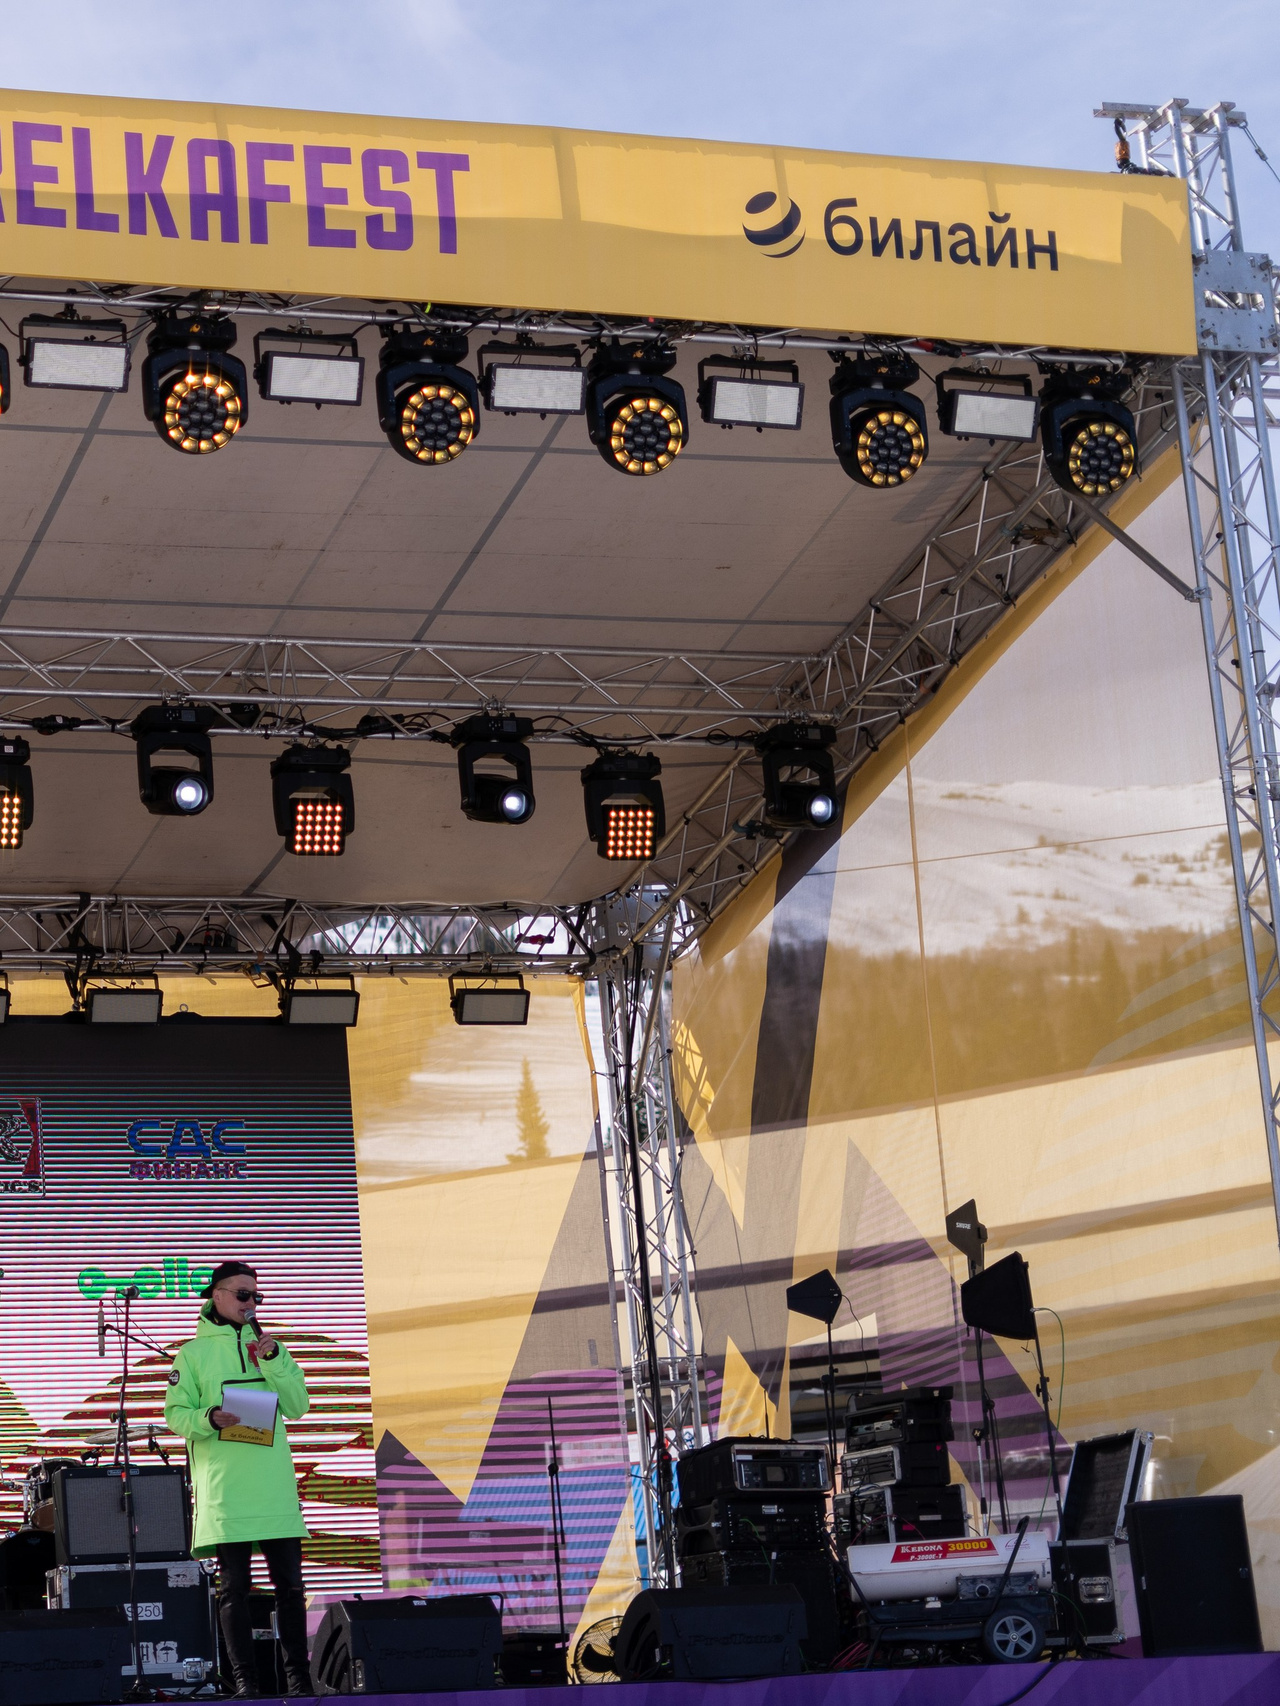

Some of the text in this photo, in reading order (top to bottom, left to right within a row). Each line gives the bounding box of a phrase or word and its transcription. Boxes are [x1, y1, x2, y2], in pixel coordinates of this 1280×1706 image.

[823, 198, 1059, 272] билайн
[128, 1161, 249, 1181] ФИНАНС
[948, 1541, 988, 1551] 30000
